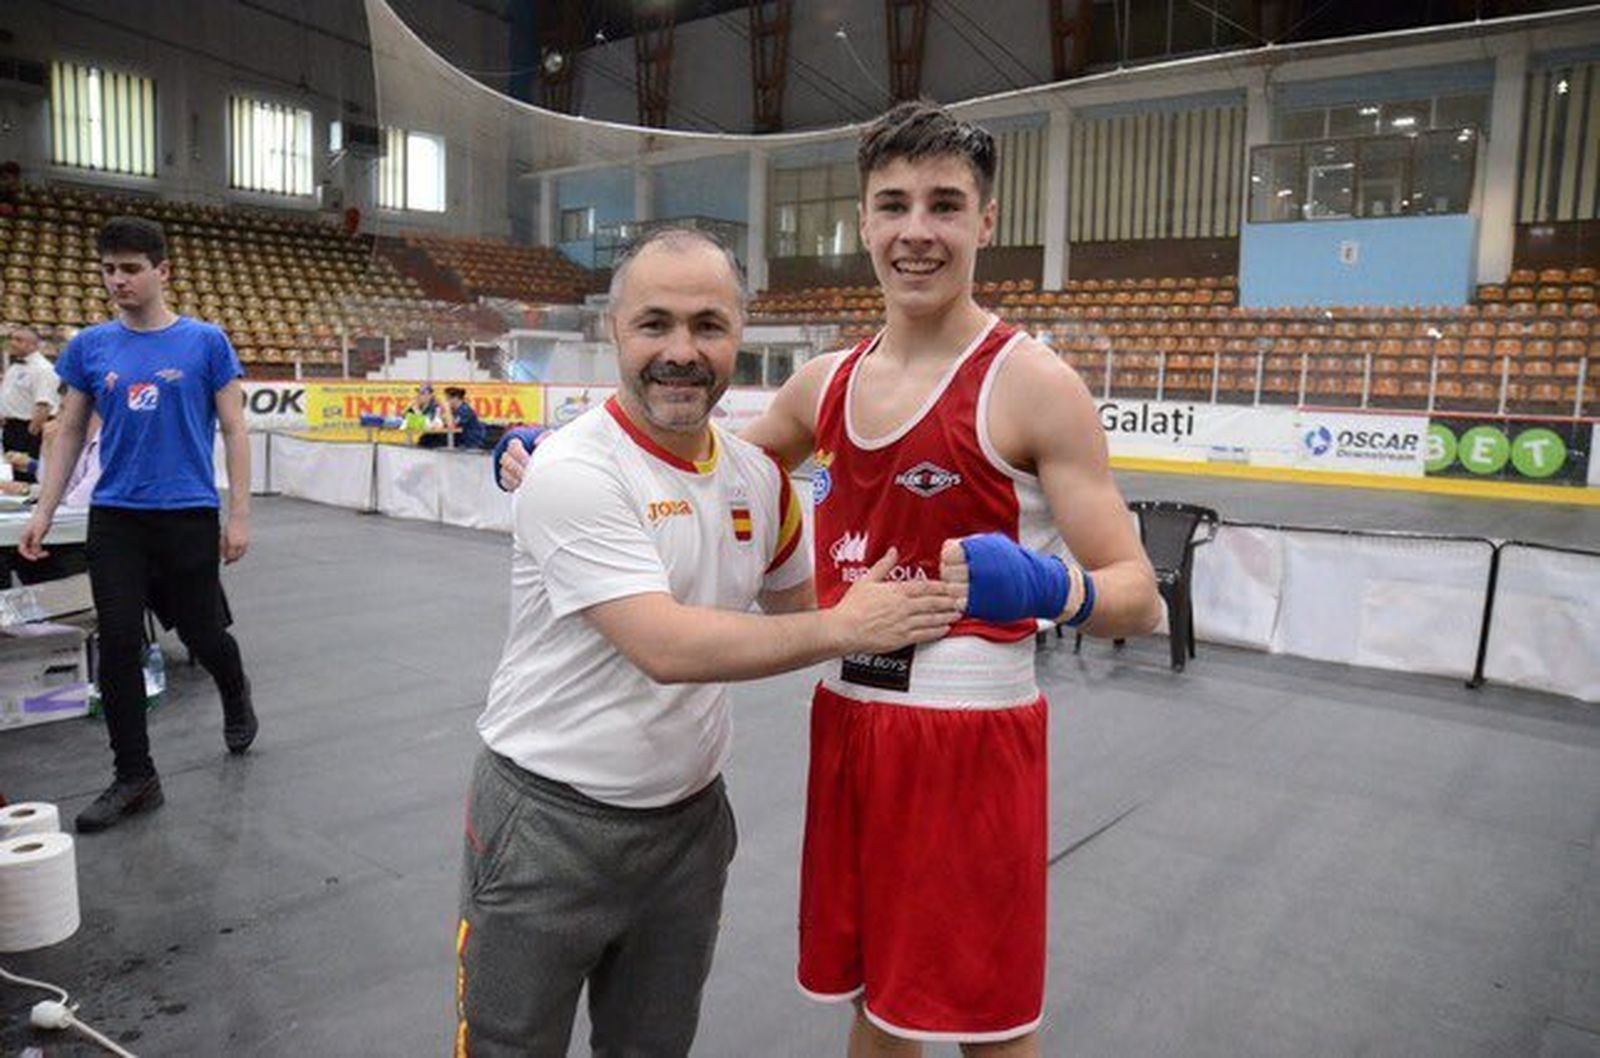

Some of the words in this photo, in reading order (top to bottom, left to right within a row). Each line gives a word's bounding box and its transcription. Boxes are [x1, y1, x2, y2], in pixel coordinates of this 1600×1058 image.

[241, 388, 304, 415] OK
[341, 395, 525, 421] INTEDIA
[1098, 402, 1195, 443] Galați
[1337, 430, 1419, 451] OSCAR
